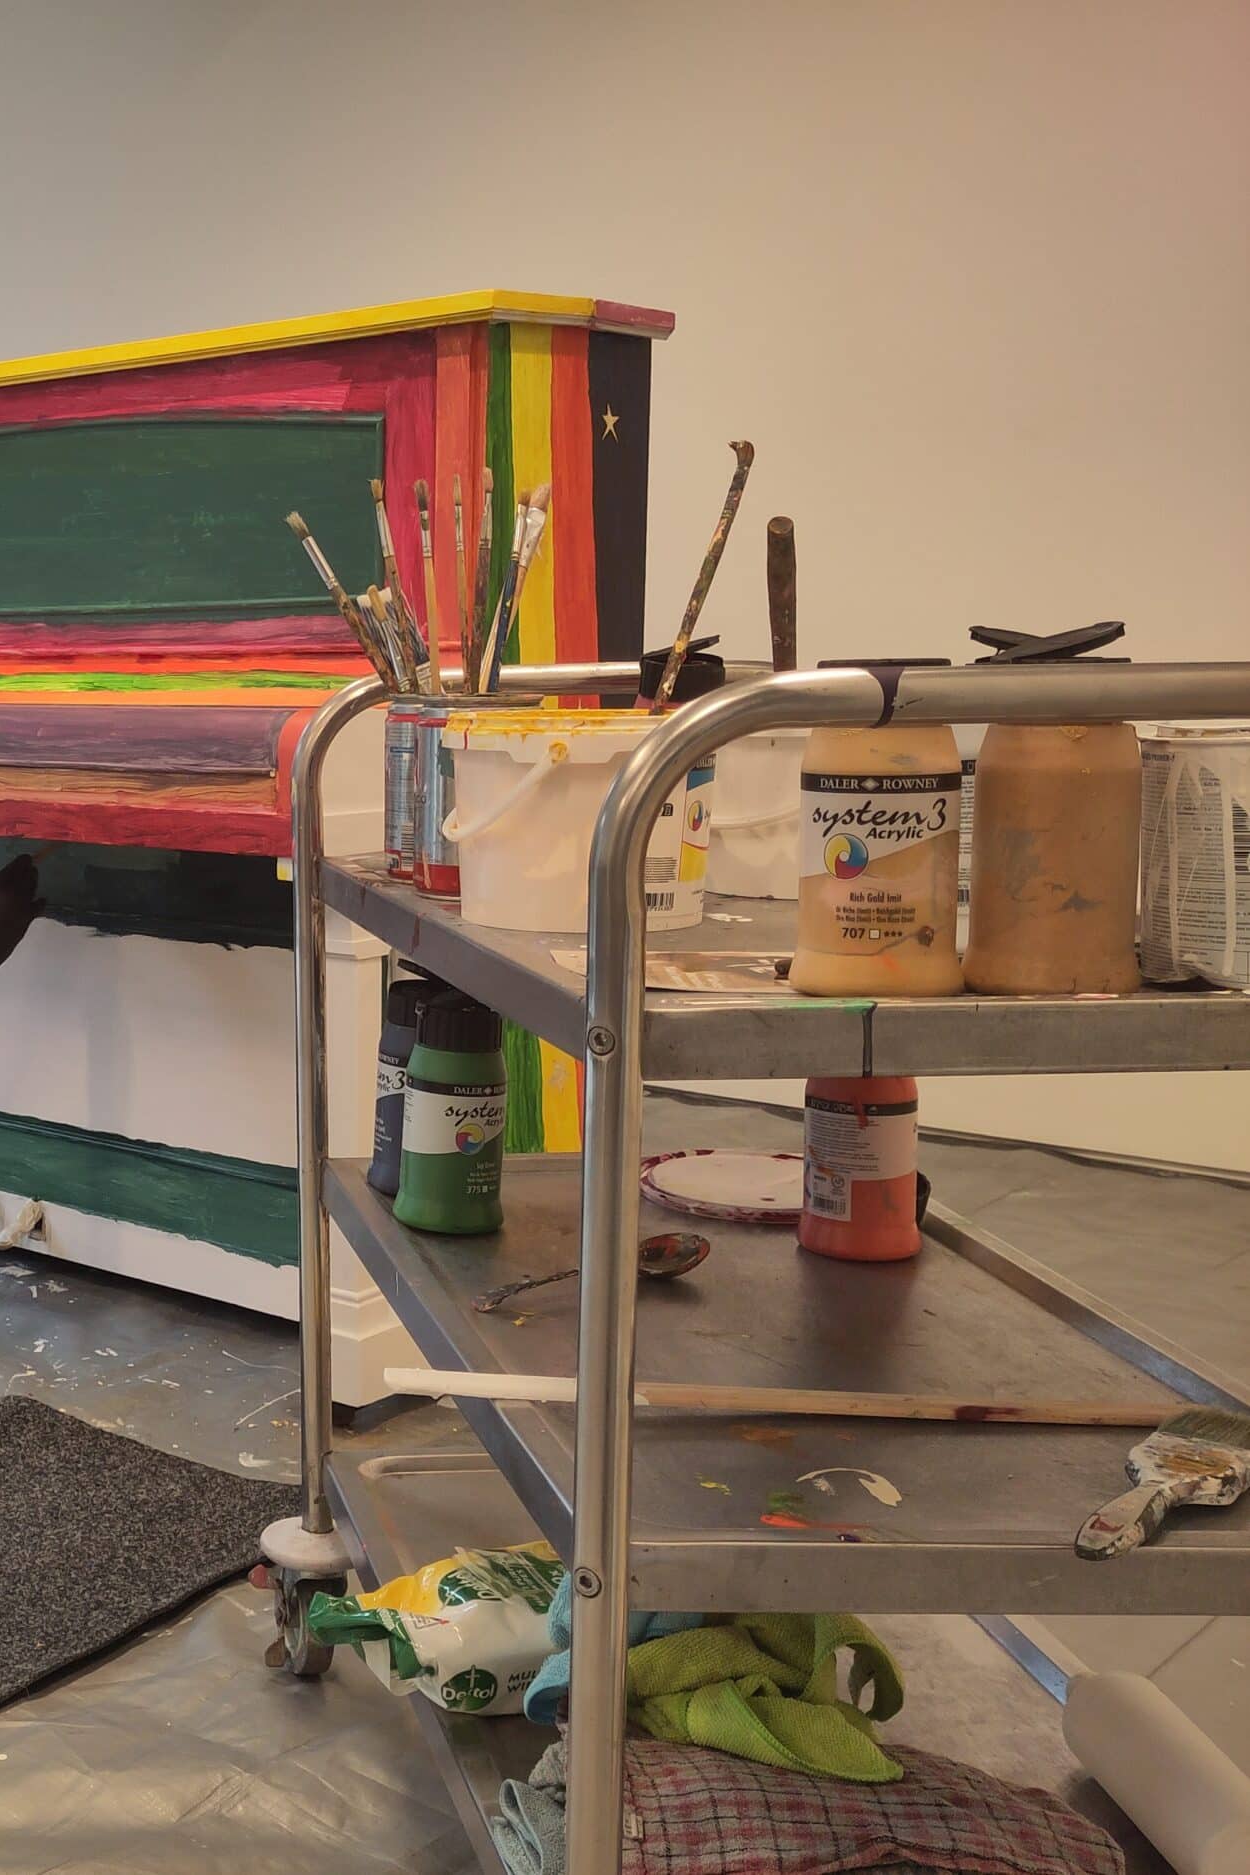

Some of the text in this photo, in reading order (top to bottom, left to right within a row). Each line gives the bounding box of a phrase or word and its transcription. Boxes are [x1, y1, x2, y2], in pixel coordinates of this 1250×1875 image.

[820, 778, 939, 789] DALER ROWNEY
[812, 799, 928, 838] system
[865, 826, 924, 842] Acrylic
[850, 892, 865, 903] Rich
[867, 891, 885, 903] Gold
[842, 927, 866, 939] 707
[453, 1086, 482, 1095] DALER
[508, 1670, 536, 1683] MUL
